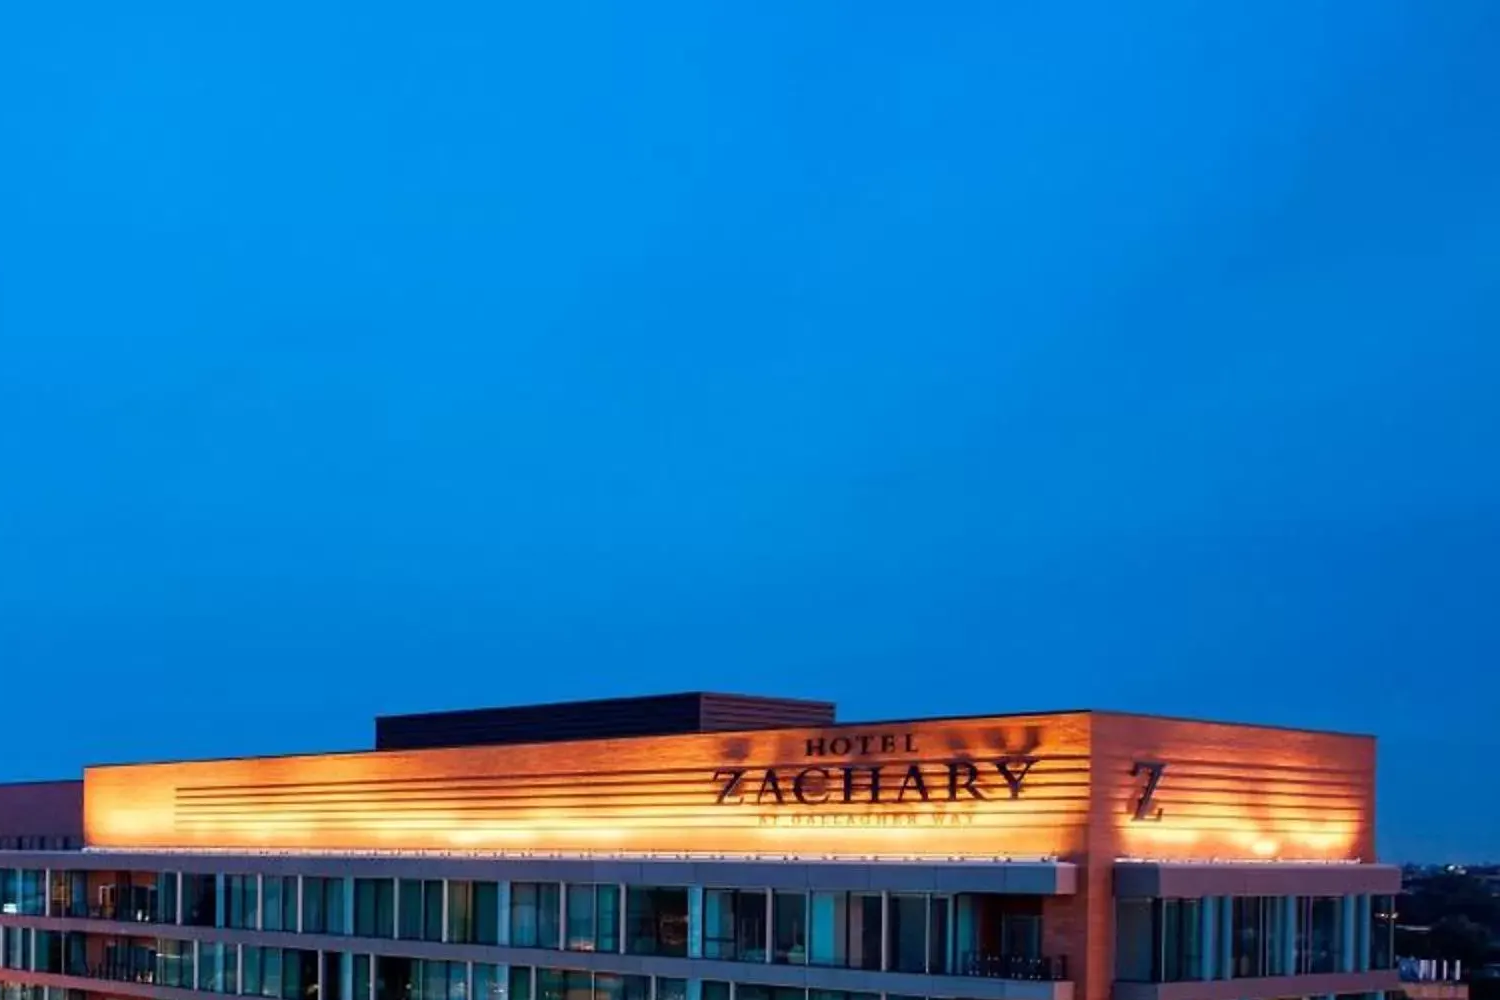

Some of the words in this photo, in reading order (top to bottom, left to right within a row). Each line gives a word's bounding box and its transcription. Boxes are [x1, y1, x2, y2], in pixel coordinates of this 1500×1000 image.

[804, 733, 920, 757] HOTEL
[712, 759, 1041, 805] ZACHARY
[1129, 761, 1169, 823] Z
